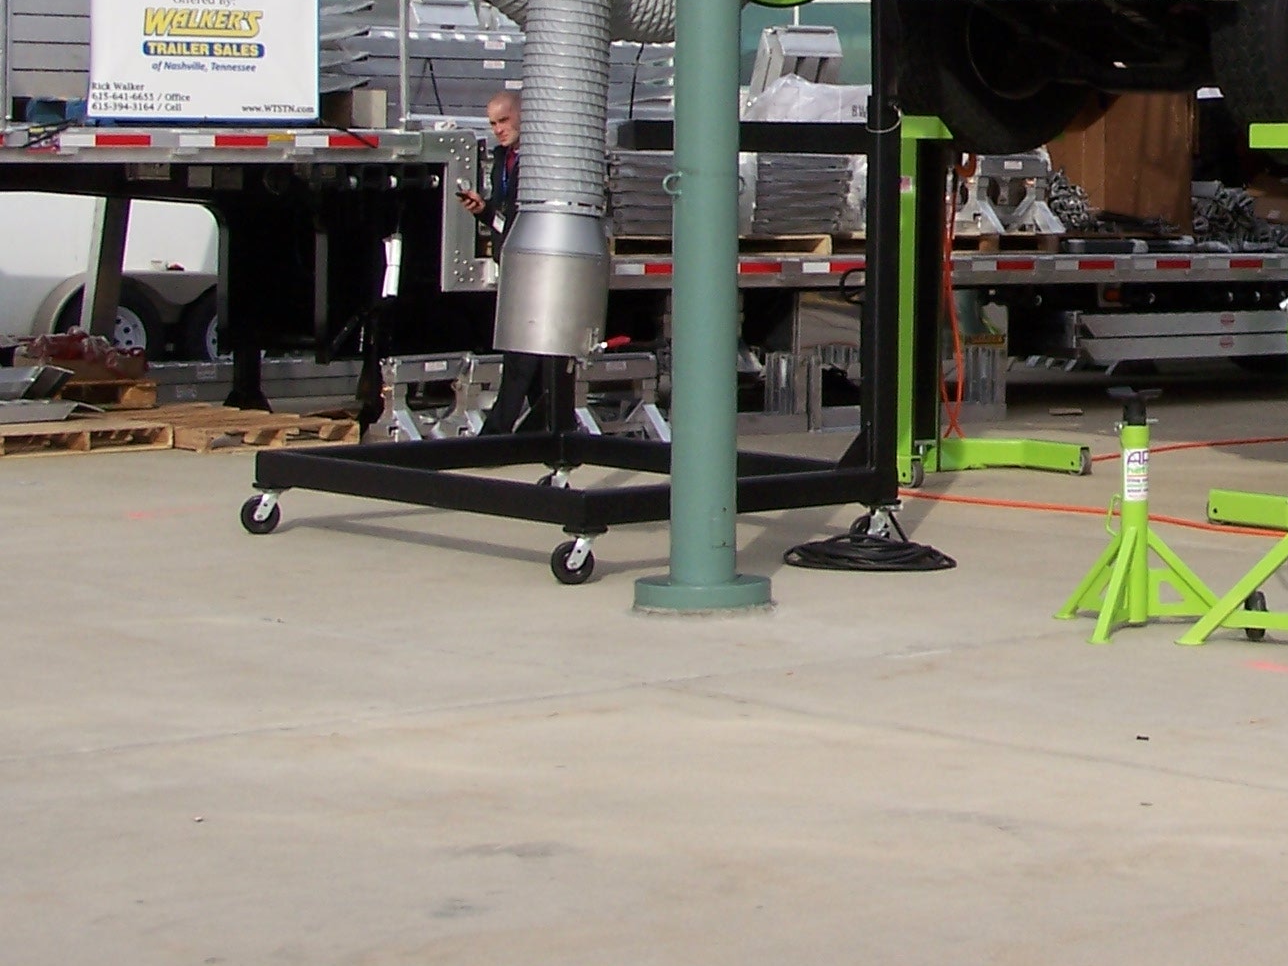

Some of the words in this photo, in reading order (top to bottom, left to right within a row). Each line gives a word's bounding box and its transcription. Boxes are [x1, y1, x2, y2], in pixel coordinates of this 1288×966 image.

[143, 6, 264, 39] WALKER'S
[147, 41, 210, 55] TRAILER
[213, 43, 260, 56] SALES
[151, 61, 162, 72] of
[164, 61, 208, 72] Nashville,
[211, 62, 257, 72] Tennessee
[91, 81, 111, 91] Rick
[113, 81, 145, 91] Walker
[164, 93, 191, 102] Office
[164, 103, 182, 112] Cell
